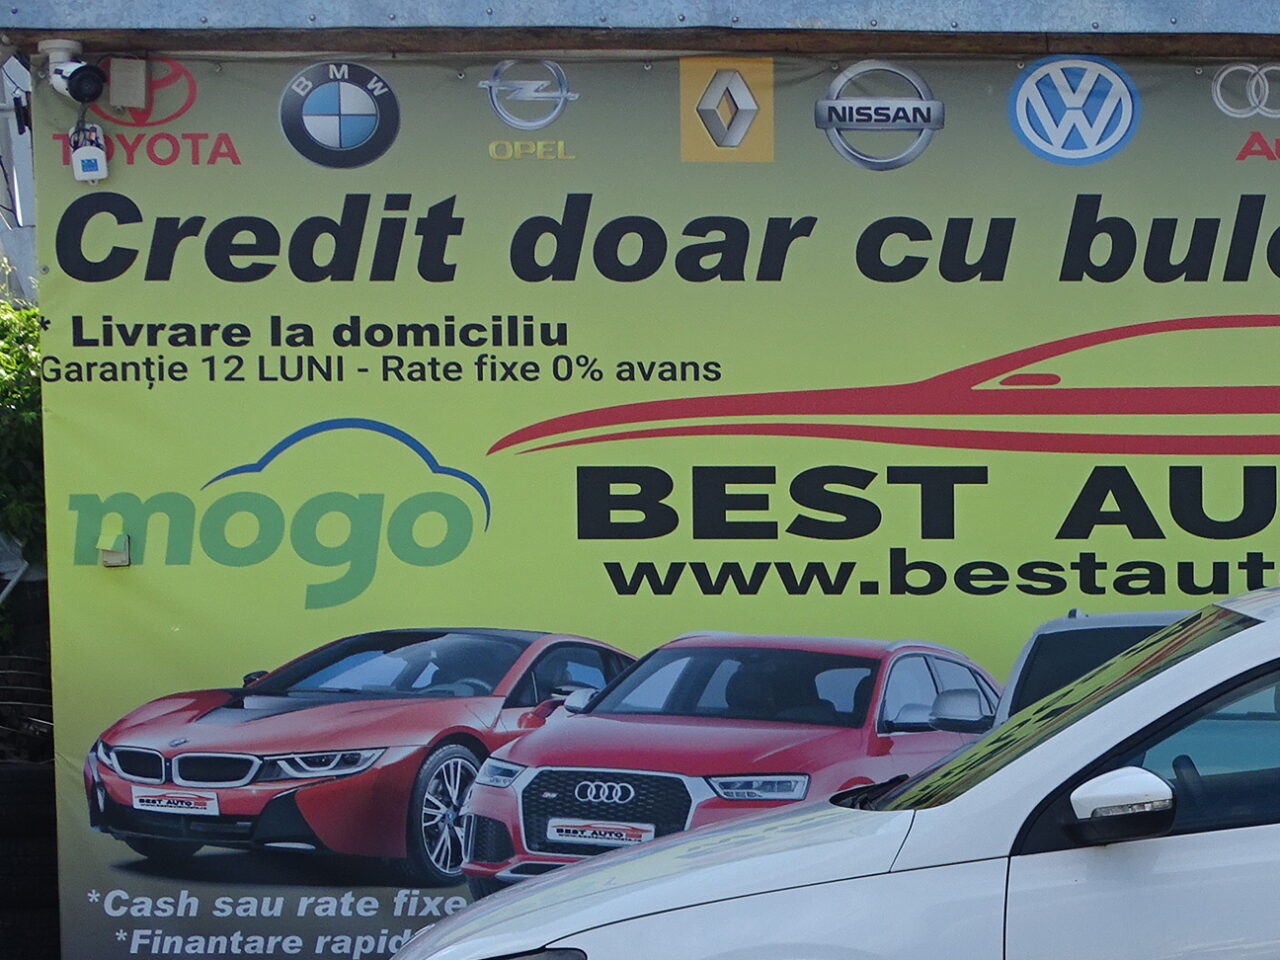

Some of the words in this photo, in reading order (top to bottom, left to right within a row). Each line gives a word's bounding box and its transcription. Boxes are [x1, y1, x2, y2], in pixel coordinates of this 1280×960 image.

[291, 64, 389, 97] BMW
[827, 105, 932, 123] NISSAN
[488, 140, 576, 160] OPEL
[55, 191, 465, 284] Credit
[509, 192, 818, 284] doar
[855, 215, 1016, 284] cu
[71, 315, 251, 347] Livrare
[270, 315, 314, 347] la
[333, 315, 569, 347] domiciliu
[41, 354, 189, 391] Garanție
[202, 355, 246, 382] 12
[258, 355, 344, 382] LUNI
[381, 355, 463, 382] Rate
[474, 353, 541, 382] fixe
[552, 354, 604, 382] 0%
[615, 360, 722, 382] avans
[576, 465, 988, 541] BEST
[67, 490, 474, 610] mogo
[212, 895, 284, 917] sau
[296, 891, 379, 917] rate
[393, 889, 468, 917] fixe
